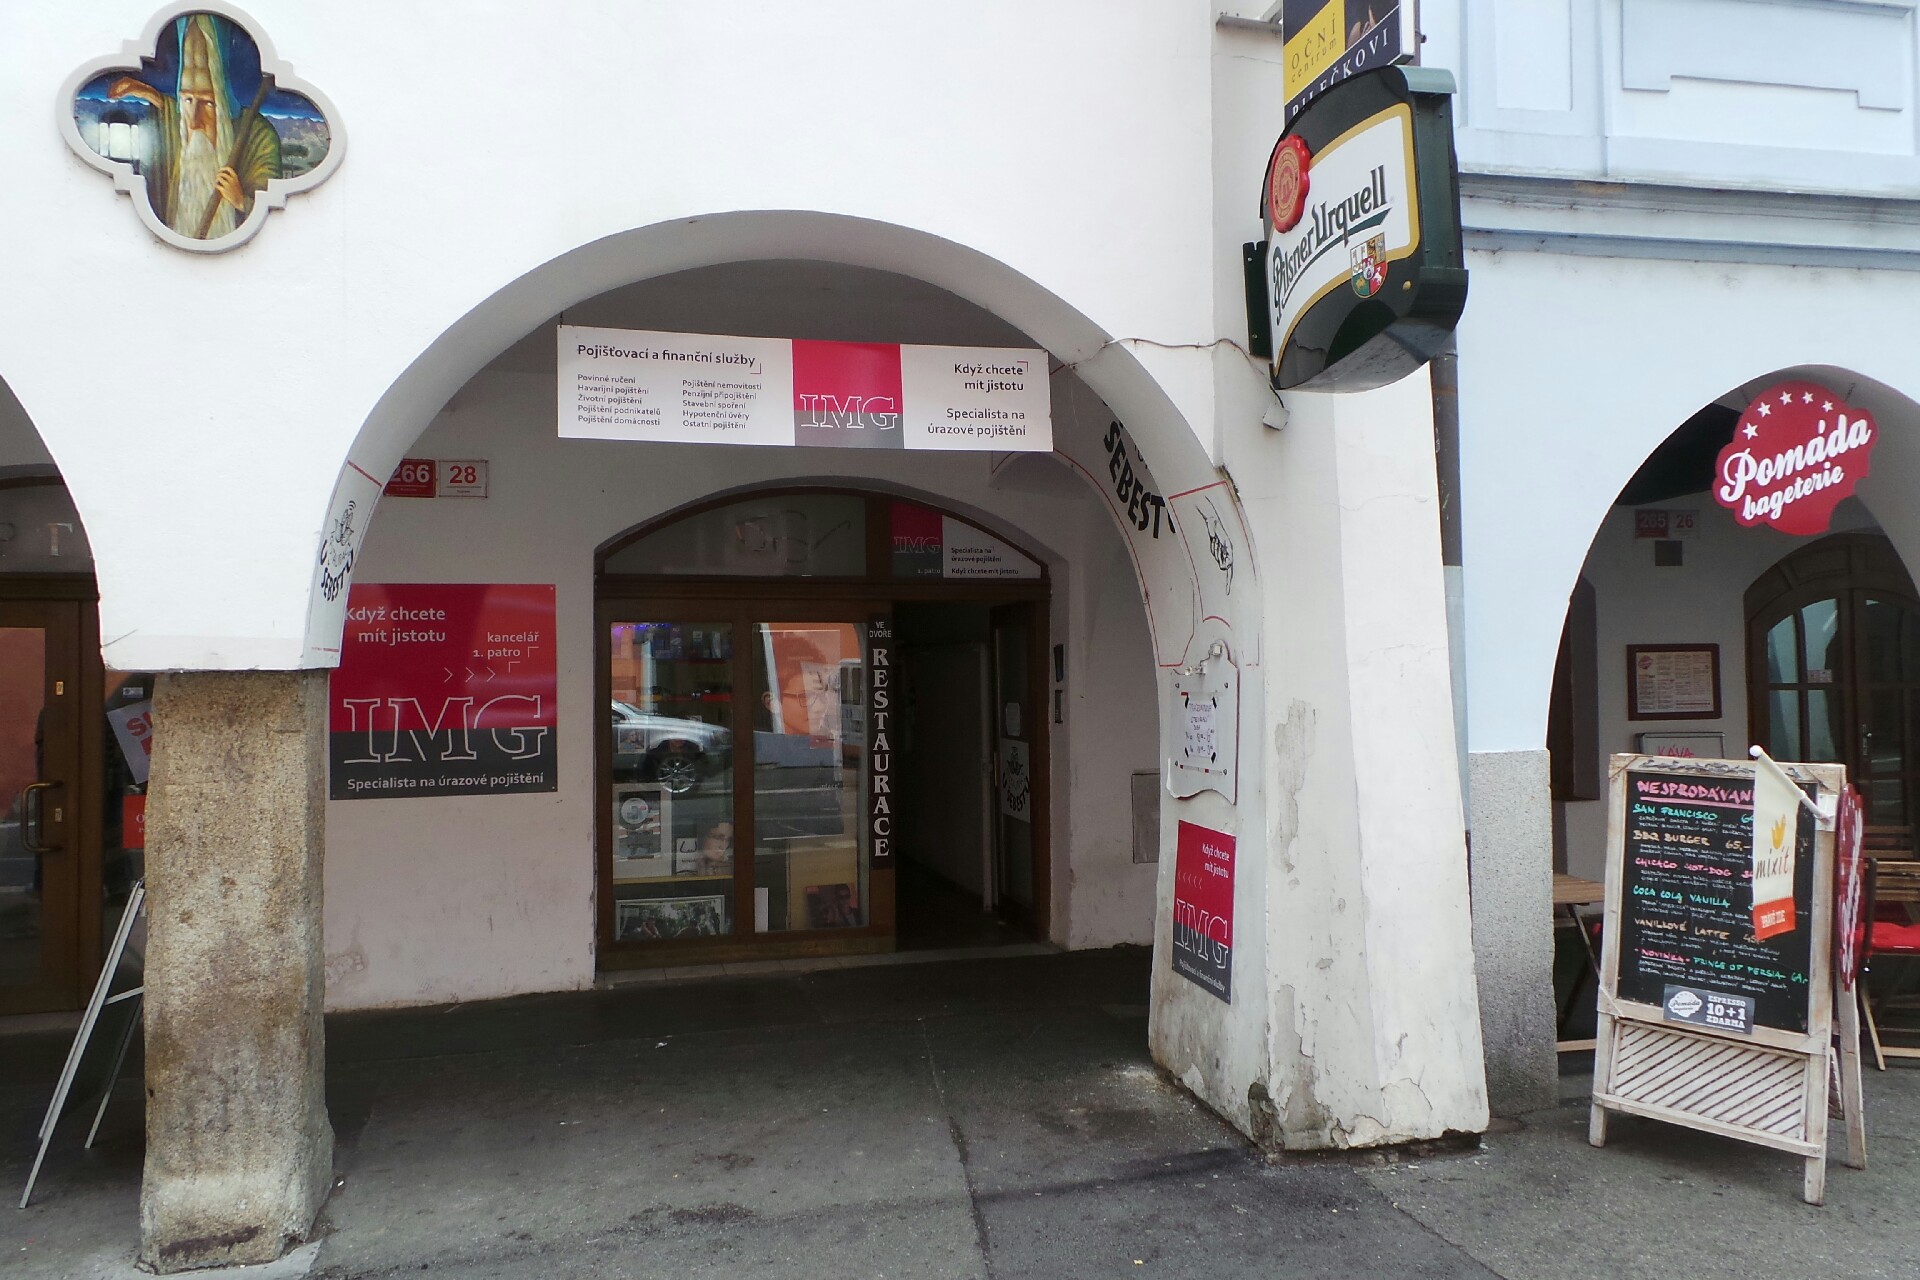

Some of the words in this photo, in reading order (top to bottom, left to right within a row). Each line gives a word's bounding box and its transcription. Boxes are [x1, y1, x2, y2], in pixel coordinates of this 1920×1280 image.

[1273, 226, 1315, 326] Pilsner
[1311, 165, 1388, 250] Urquell
[577, 344, 649, 361] Pojišťovací
[652, 351, 659, 361] a
[661, 350, 713, 364] finanční
[715, 352, 756, 368] služby
[953, 362, 983, 377] Když
[985, 365, 1024, 376] chcete
[577, 374, 609, 383] Povinné
[611, 376, 636, 384] ručení
[682, 379, 716, 389] Pojištění
[716, 382, 762, 390] nemovitosti
[964, 379, 984, 391] mít
[985, 380, 1025, 393] jistotu
[577, 384, 614, 394] Havarijní
[615, 386, 649, 396] pojištění
[682, 389, 713, 399] Penzijní
[577, 393, 606, 402] Životní
[607, 396, 642, 405] pojištění
[682, 399, 717, 408] Stavební
[717, 401, 746, 410] spoření
[577, 404, 613, 414] Pojištění
[614, 407, 661, 416] podnikatelů
[800, 394, 898, 430] IMG
[946, 407, 1009, 422] Specialista
[1010, 410, 1026, 421] na
[577, 414, 613, 424] Pojištění
[614, 417, 661, 426] domácnosti
[682, 420, 711, 428] Ostatní
[713, 421, 746, 431] pojištění
[927, 423, 974, 436] úrazové
[976, 424, 1027, 439] pojištění
[1719, 414, 1872, 503] Pomáda
[449, 465, 477, 484] 28
[1742, 461, 1845, 521] bageterie
[1676, 513, 1694, 529] 26
[345, 607, 386, 624] Když
[390, 607, 446, 621] chcete
[875, 621, 885, 629] VE
[358, 628, 387, 643] mít
[389, 629, 446, 647] jistotu
[487, 631, 540, 643] kancelář
[473, 649, 484, 658] 1.
[487, 647, 521, 660] patro
[343, 694, 548, 764] IMG
[872, 648, 891, 857] RESTAURACE
[347, 777, 416, 792] Specialista
[420, 778, 435, 788] na
[438, 775, 487, 787] úrazové
[490, 772, 544, 787] pojištění
[1633, 803, 1655, 814] SAN
[1660, 807, 1718, 820] FRANCISCO
[1633, 830, 1660, 841] BBQ
[1664, 833, 1711, 846] BURGER
[1213, 846, 1230, 862] chcete
[1635, 857, 1679, 869] CHICAGO
[1755, 848, 1790, 880] mixit
[1633, 885, 1656, 896] COCA
[1660, 890, 1683, 903] COLA
[1689, 894, 1731, 908] VANILLA
[1174, 898, 1229, 969] IMG
[1695, 926, 1731, 940] LATTE
[1693, 956, 1725, 971] PRINCE
[1747, 966, 1786, 980] PERSIA
[1706, 1014, 1746, 1028] ZDARMA
